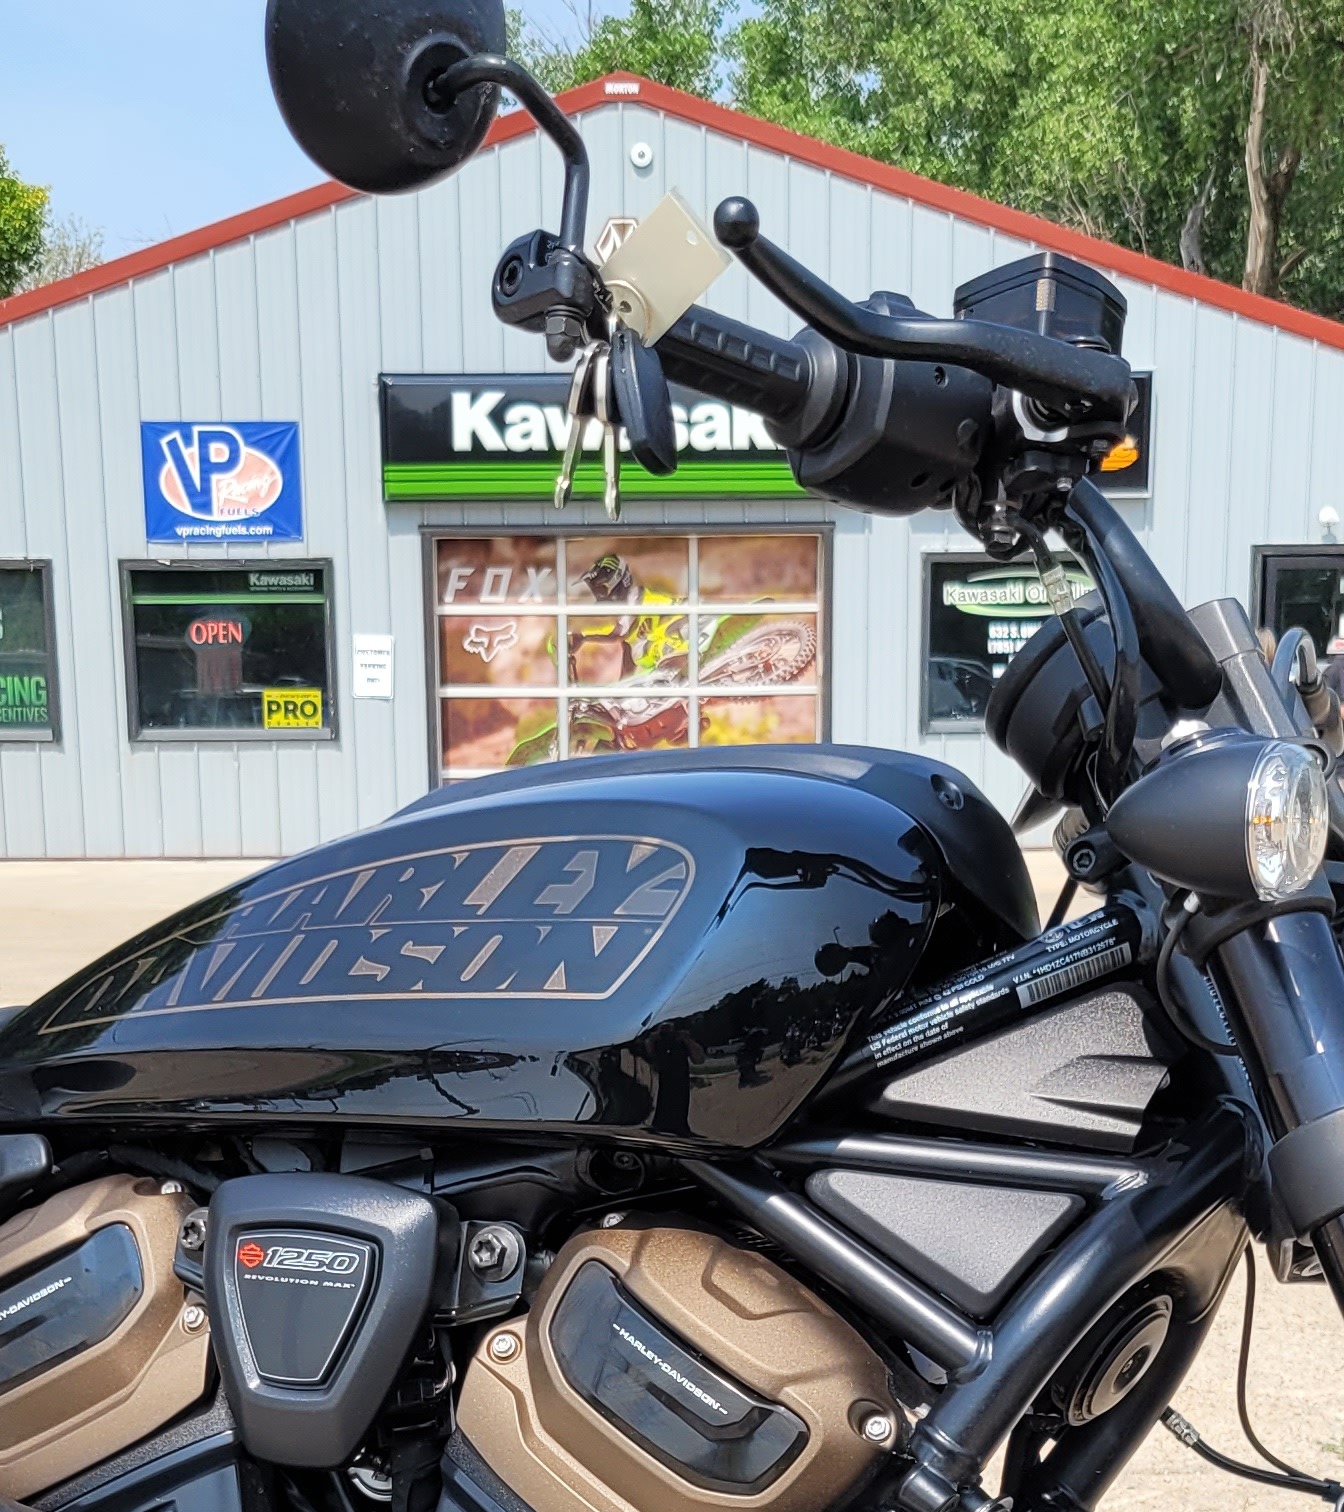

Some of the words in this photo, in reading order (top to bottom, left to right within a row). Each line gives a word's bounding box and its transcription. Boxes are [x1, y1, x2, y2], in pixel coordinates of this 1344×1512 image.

[163, 428, 243, 517] VP
[220, 508, 260, 516] FUELS
[175, 526, 273, 538] vpracingfuels.com
[249, 573, 315, 586] Kawasaki
[444, 566, 553, 604] FOX
[944, 582, 1023, 604] Kawasaki
[190, 622, 243, 645] OPEN
[267, 701, 318, 721] PRO
[263, 1245, 360, 1275] 1250
[244, 1274, 319, 1286] REVOLUTION
